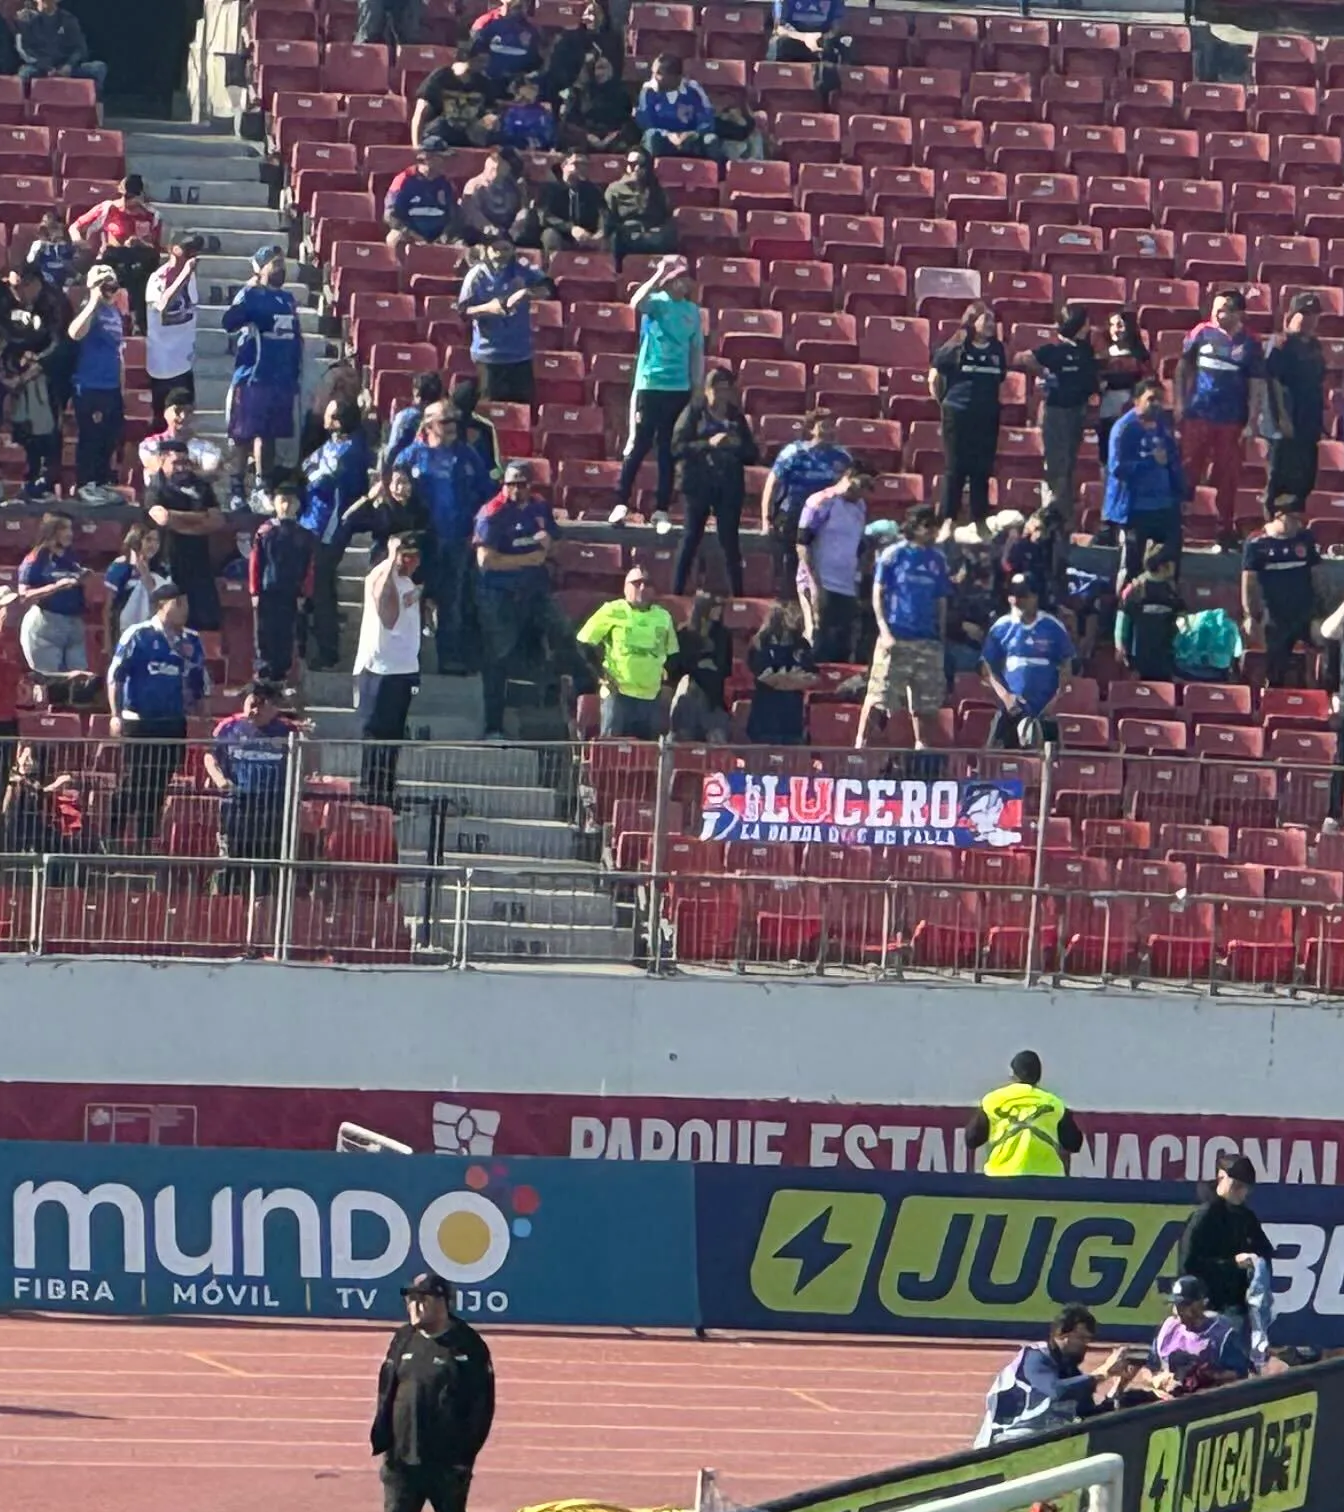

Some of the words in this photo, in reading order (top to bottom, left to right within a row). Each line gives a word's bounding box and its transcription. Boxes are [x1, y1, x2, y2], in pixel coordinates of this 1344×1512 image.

[760, 774, 959, 829] LUCERO
[13, 1277, 115, 1302] FIBRA
[173, 1279, 279, 1308] MÓVIL
[336, 1287, 378, 1310] TV
[456, 1290, 509, 1313] IJO
